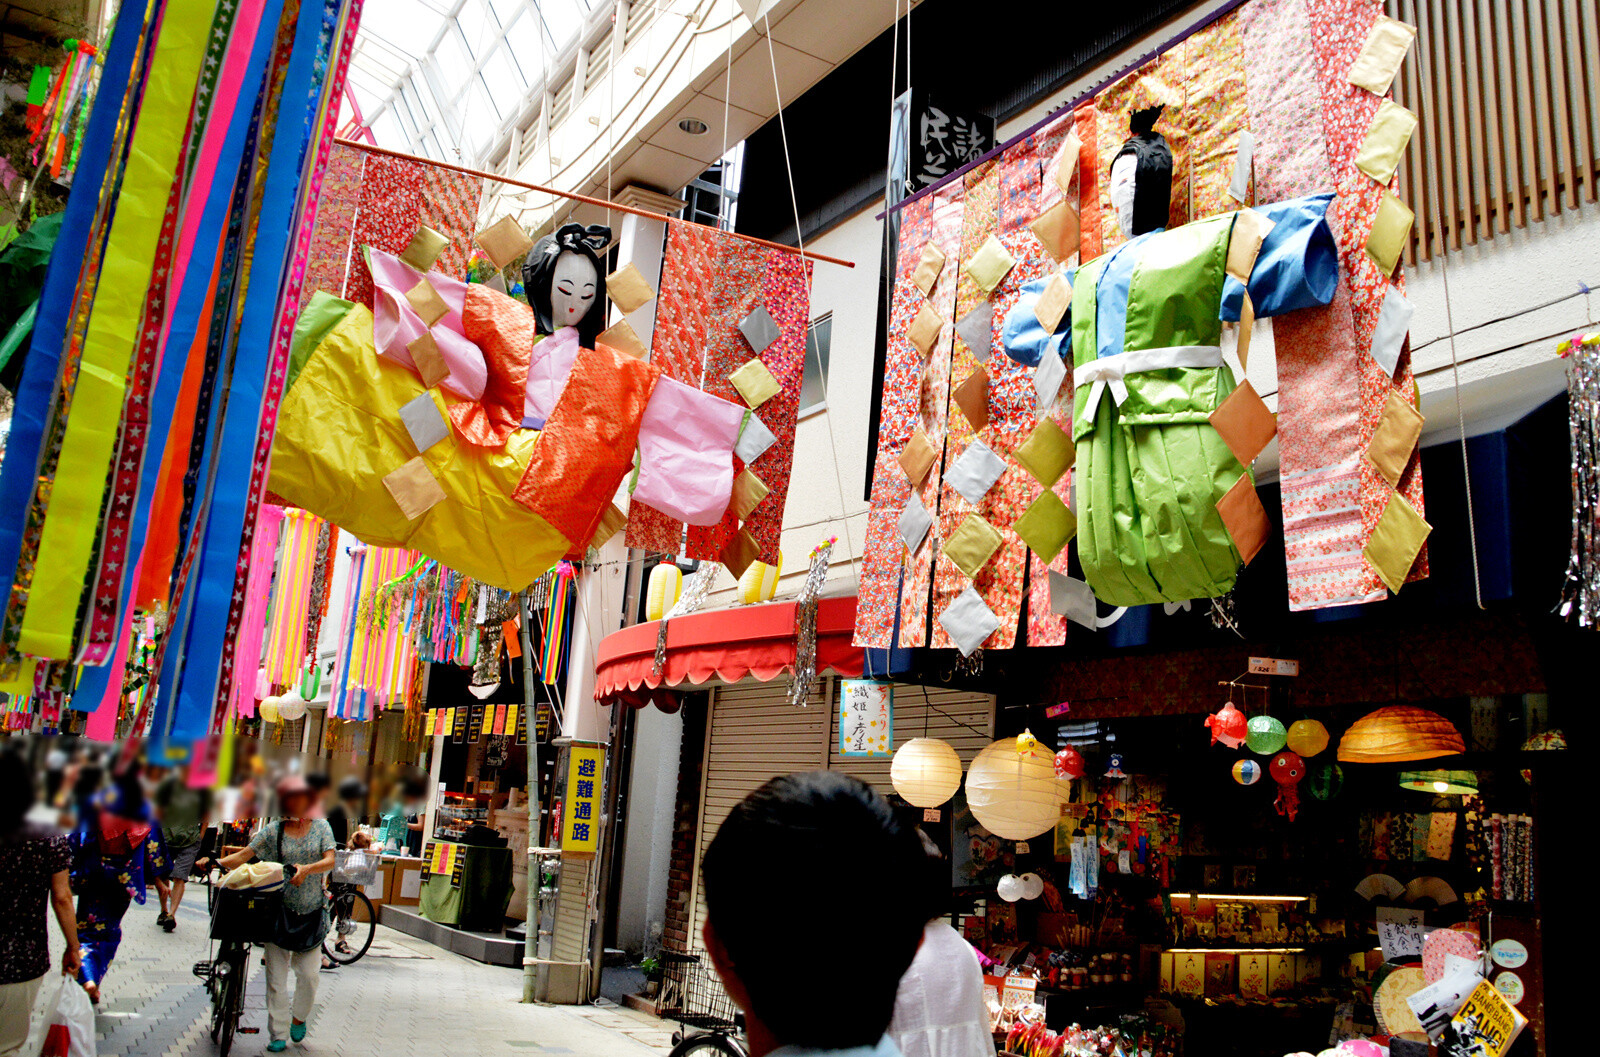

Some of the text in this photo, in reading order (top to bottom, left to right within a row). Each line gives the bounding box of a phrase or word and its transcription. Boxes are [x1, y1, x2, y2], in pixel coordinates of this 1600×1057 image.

[877, 685, 887, 731] 七夕まつり
[572, 758, 596, 841] 避難通路
[1459, 1000, 1506, 1055] BANG!
